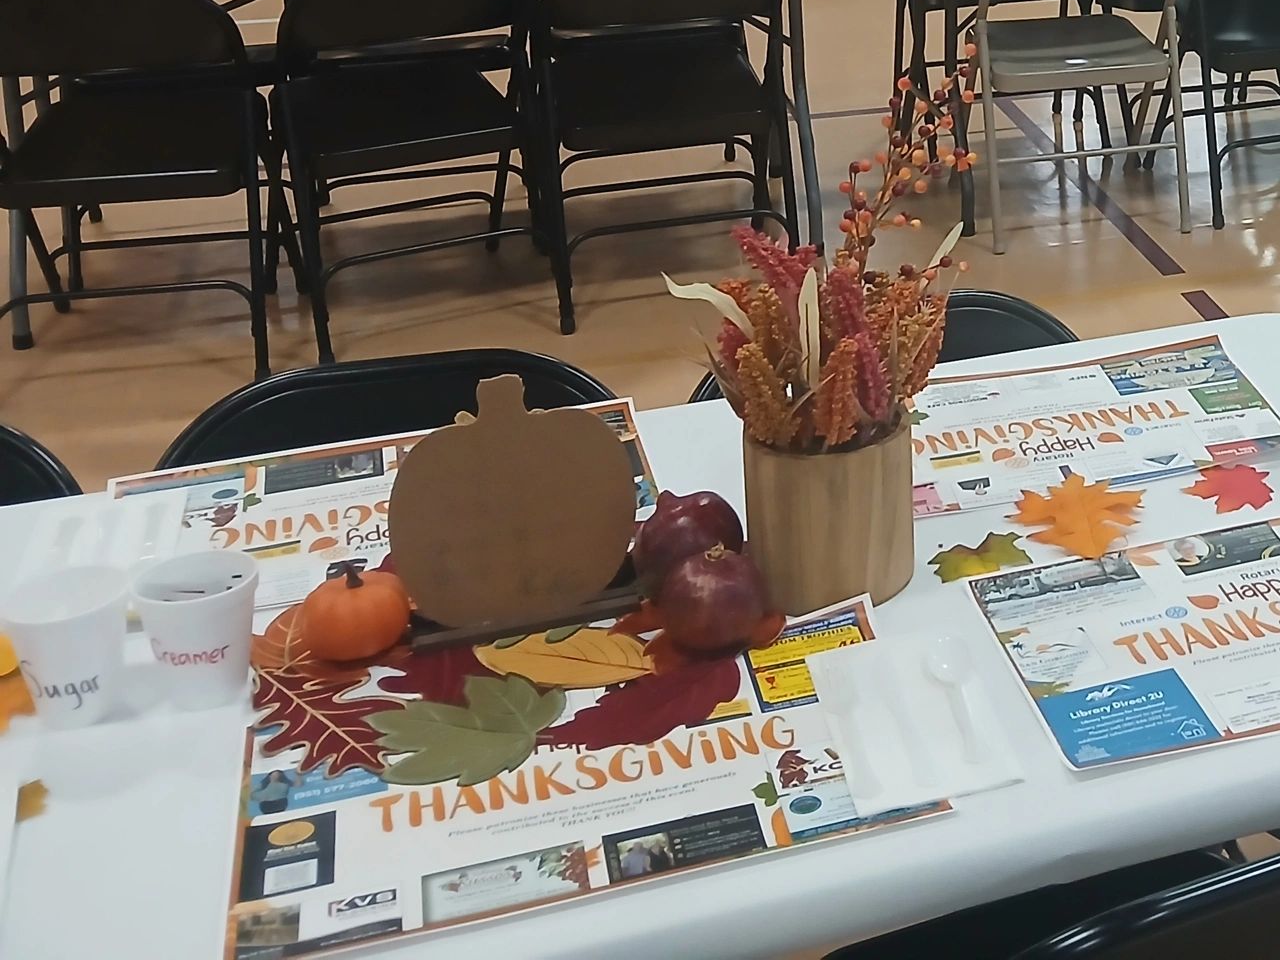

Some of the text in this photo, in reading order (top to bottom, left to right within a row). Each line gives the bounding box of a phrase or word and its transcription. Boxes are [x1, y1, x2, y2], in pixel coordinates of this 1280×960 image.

[1018, 435, 1096, 460] Happy
[1119, 613, 1164, 628] Interact
[149, 637, 230, 667] Creamer
[19, 659, 101, 710] Sugar
[1069, 690, 1164, 720] Library Direct 2U
[560, 814, 601, 829] THANK
[332, 887, 397, 915] KVS
